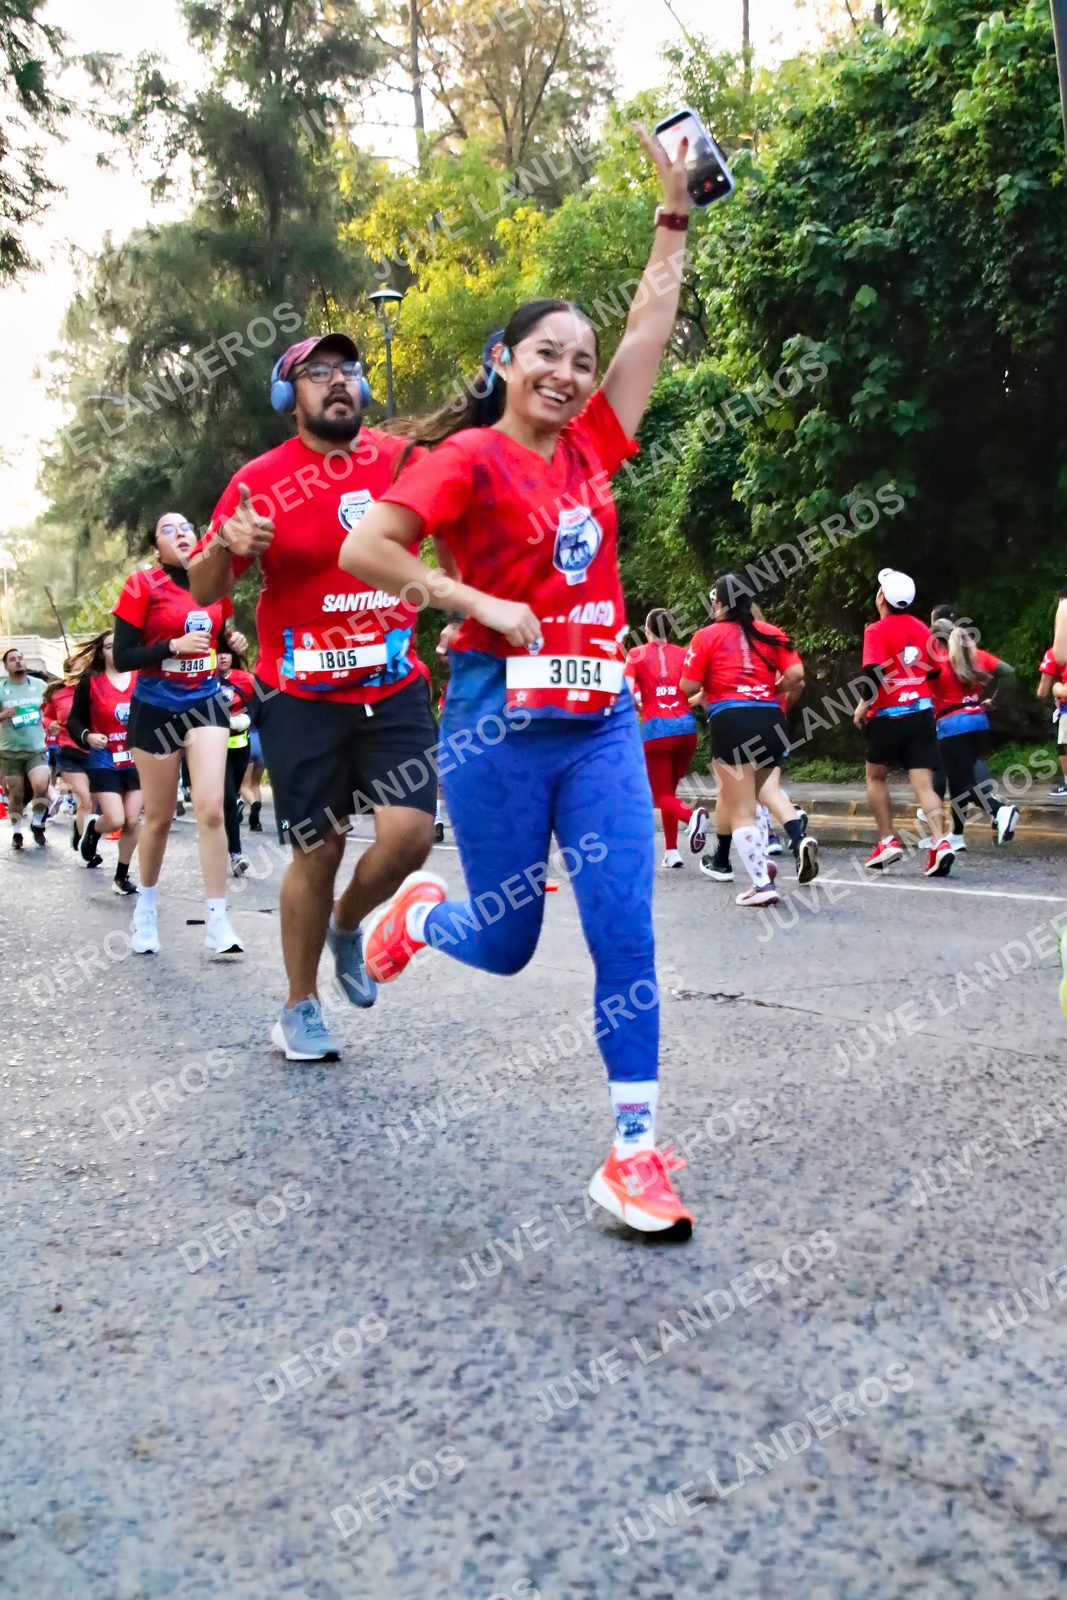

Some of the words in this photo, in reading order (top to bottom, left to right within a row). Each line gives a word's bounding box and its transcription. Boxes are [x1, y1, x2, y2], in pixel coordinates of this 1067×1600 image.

[180, 659, 204, 672] 3348
[318, 650, 358, 669] 1805
[550, 658, 602, 686] 3054
